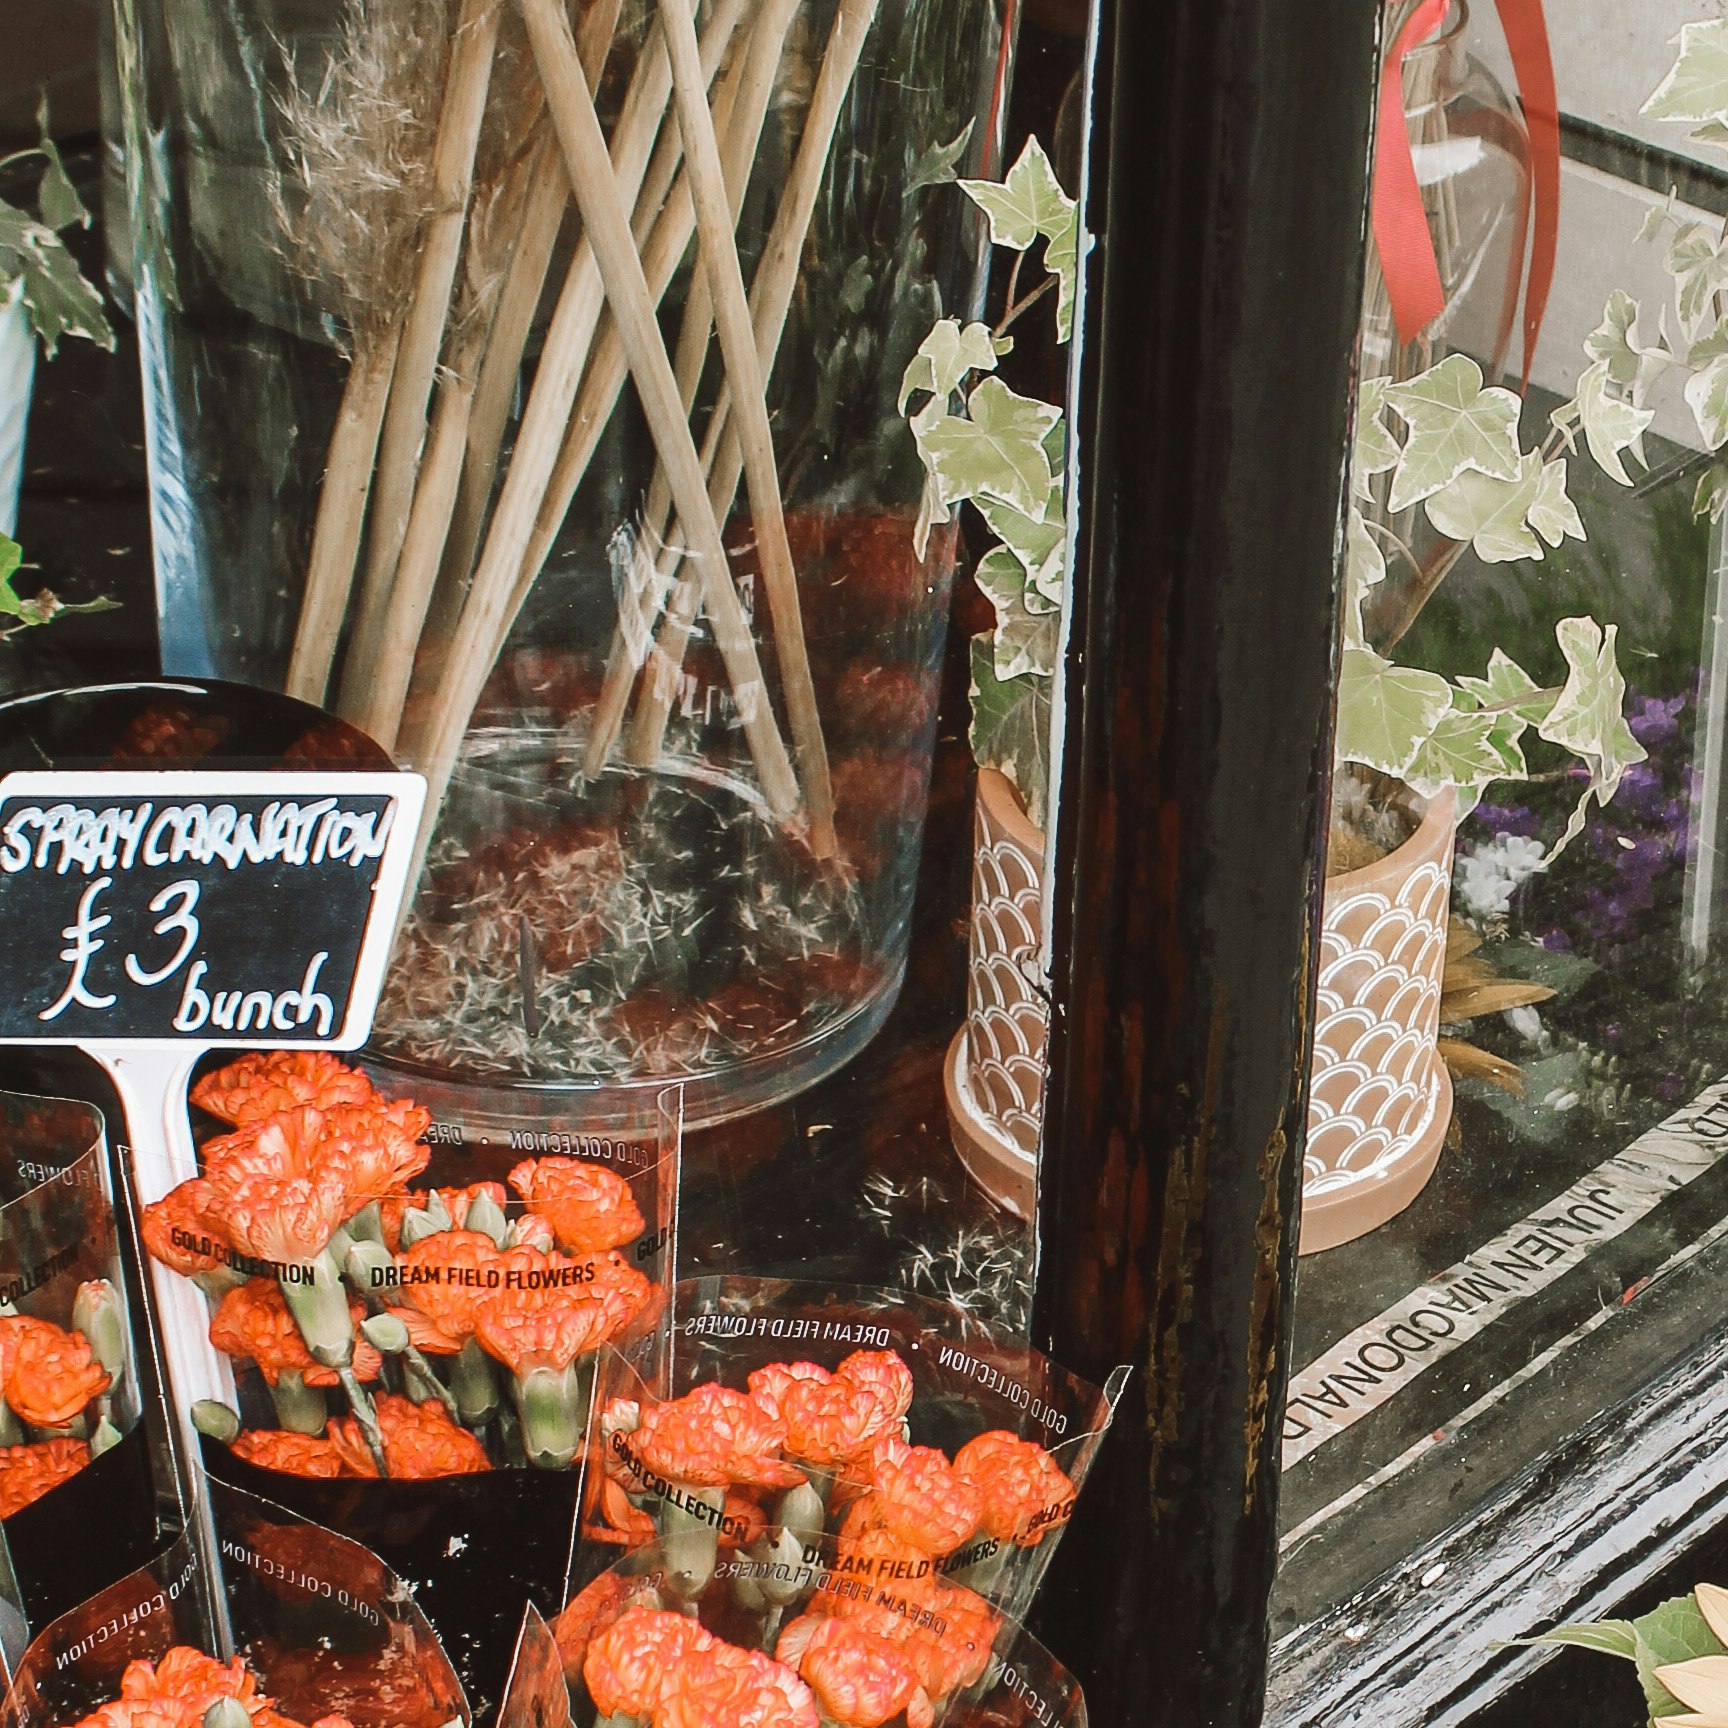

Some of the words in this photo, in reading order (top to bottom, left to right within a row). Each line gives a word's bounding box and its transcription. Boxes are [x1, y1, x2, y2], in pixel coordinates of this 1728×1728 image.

[0, 802, 154, 874] SPRAY
[142, 797, 397, 871] CARNATION
[172, 951, 334, 1038] bunch
[170, 1226, 214, 1258] GOLD
[213, 1242, 316, 1286] COLLECTION
[370, 1264, 441, 1288] DREAM
[446, 1266, 500, 1290] FIELD
[505, 1262, 595, 1291] FLOWERS
[1490, 1187, 1626, 1284] JULIEN
[1281, 1271, 1514, 1440] MACDONALD
[610, 1433, 645, 1484] GOLD
[640, 1472, 750, 1543] COLLECTION
[800, 1545, 873, 1576] DREAM
[878, 1557, 929, 1579] FIELD
[932, 1536, 999, 1575] FLOWERS
